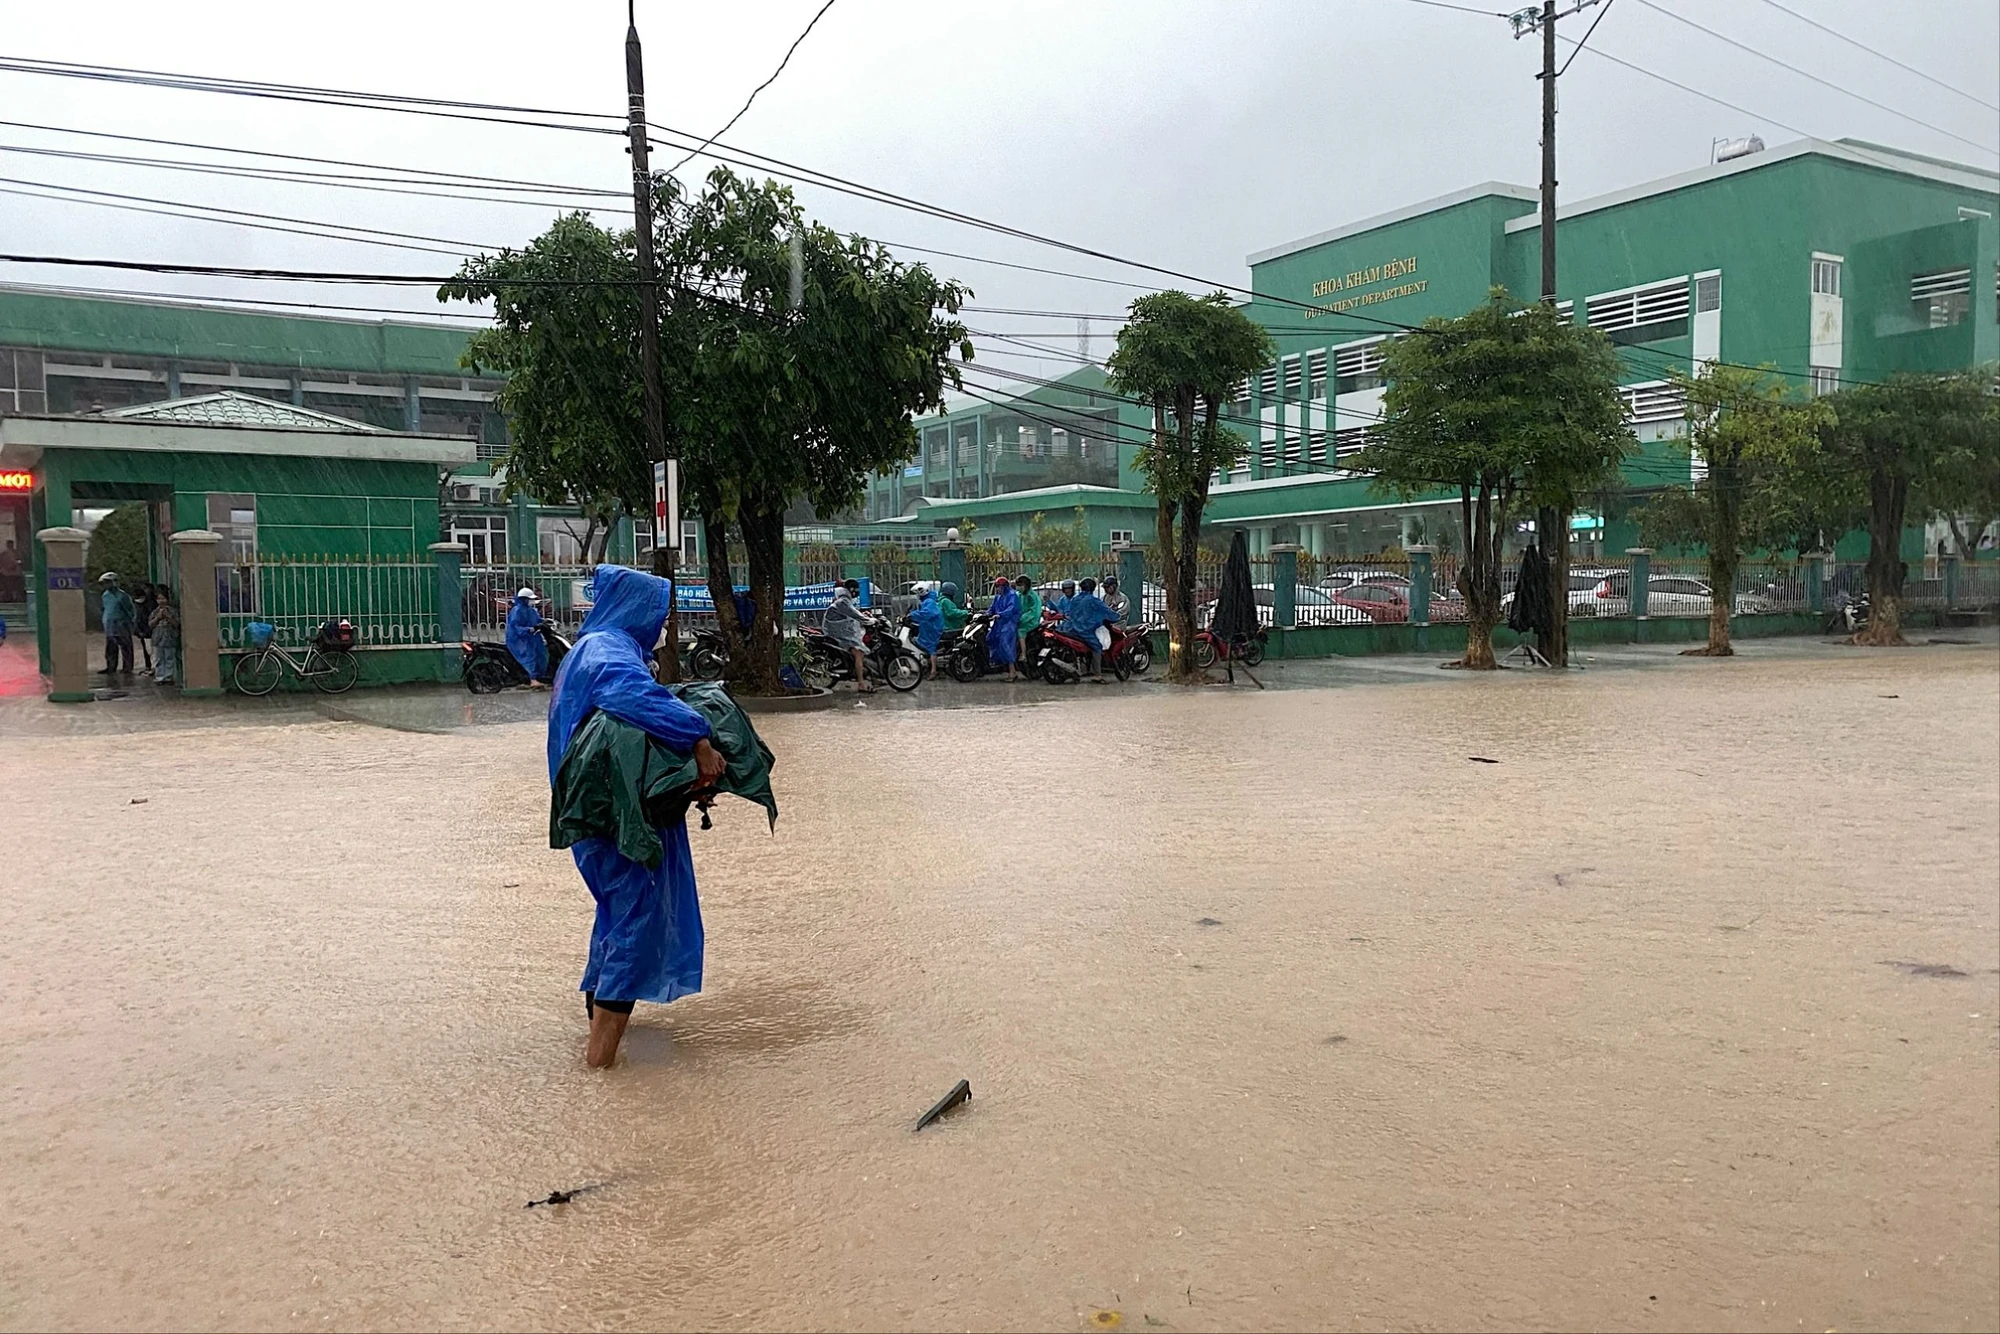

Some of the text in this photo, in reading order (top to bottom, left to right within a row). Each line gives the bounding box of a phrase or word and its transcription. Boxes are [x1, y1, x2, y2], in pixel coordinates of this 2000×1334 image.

[1312, 256, 1417, 298] KHOA KHÁM BỆNH
[1362, 280, 1428, 306] DEPARTMENT
